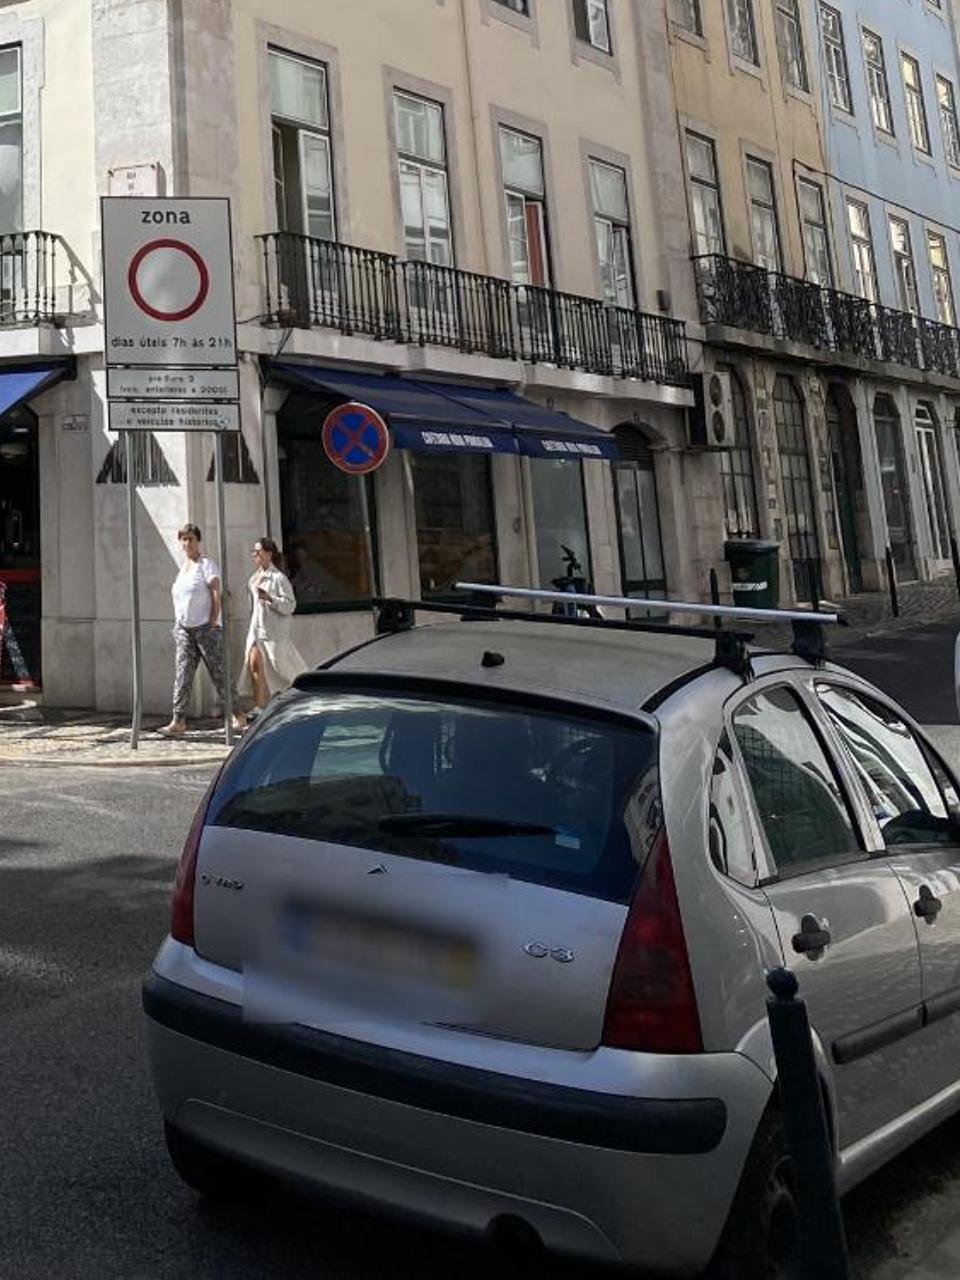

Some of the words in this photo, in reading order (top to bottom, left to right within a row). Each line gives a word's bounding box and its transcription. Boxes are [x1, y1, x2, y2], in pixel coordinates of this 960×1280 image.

[141, 210, 191, 224] zona
[111, 336, 134, 348] dias
[173, 336, 187, 348] 7h
[208, 336, 232, 348] 21h
